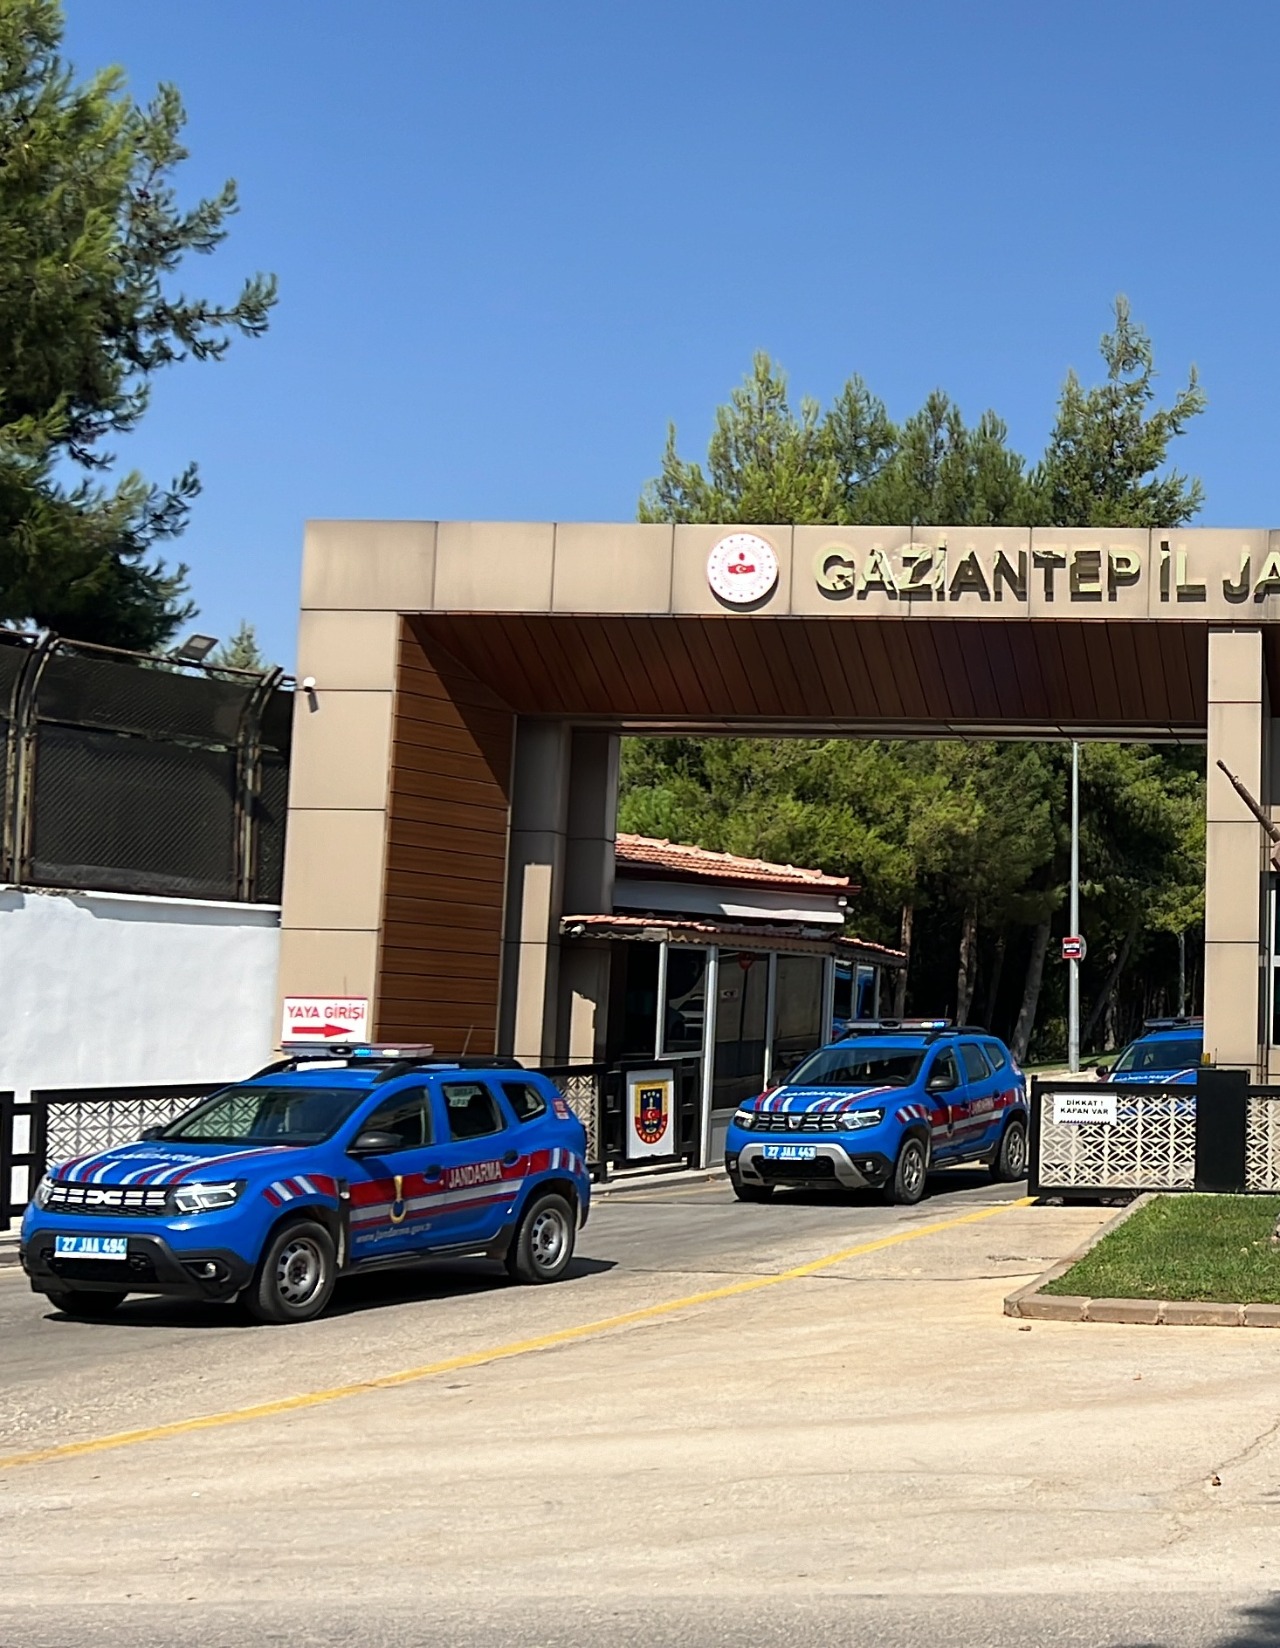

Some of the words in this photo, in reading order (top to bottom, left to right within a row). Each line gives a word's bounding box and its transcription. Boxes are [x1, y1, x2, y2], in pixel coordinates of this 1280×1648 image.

[815, 537, 1142, 602] GAZİANTEP
[1159, 539, 1207, 603] İL
[288, 1006, 320, 1018] YAYA
[324, 1003, 364, 1021] GİRİŞİ
[767, 1146, 779, 1157] 27
[780, 1146, 796, 1157] JAA
[449, 1160, 502, 1188] JANDARMA
[61, 1236, 77, 1252] 27
[78, 1237, 100, 1252] JAA
[102, 1238, 125, 1254] 494
